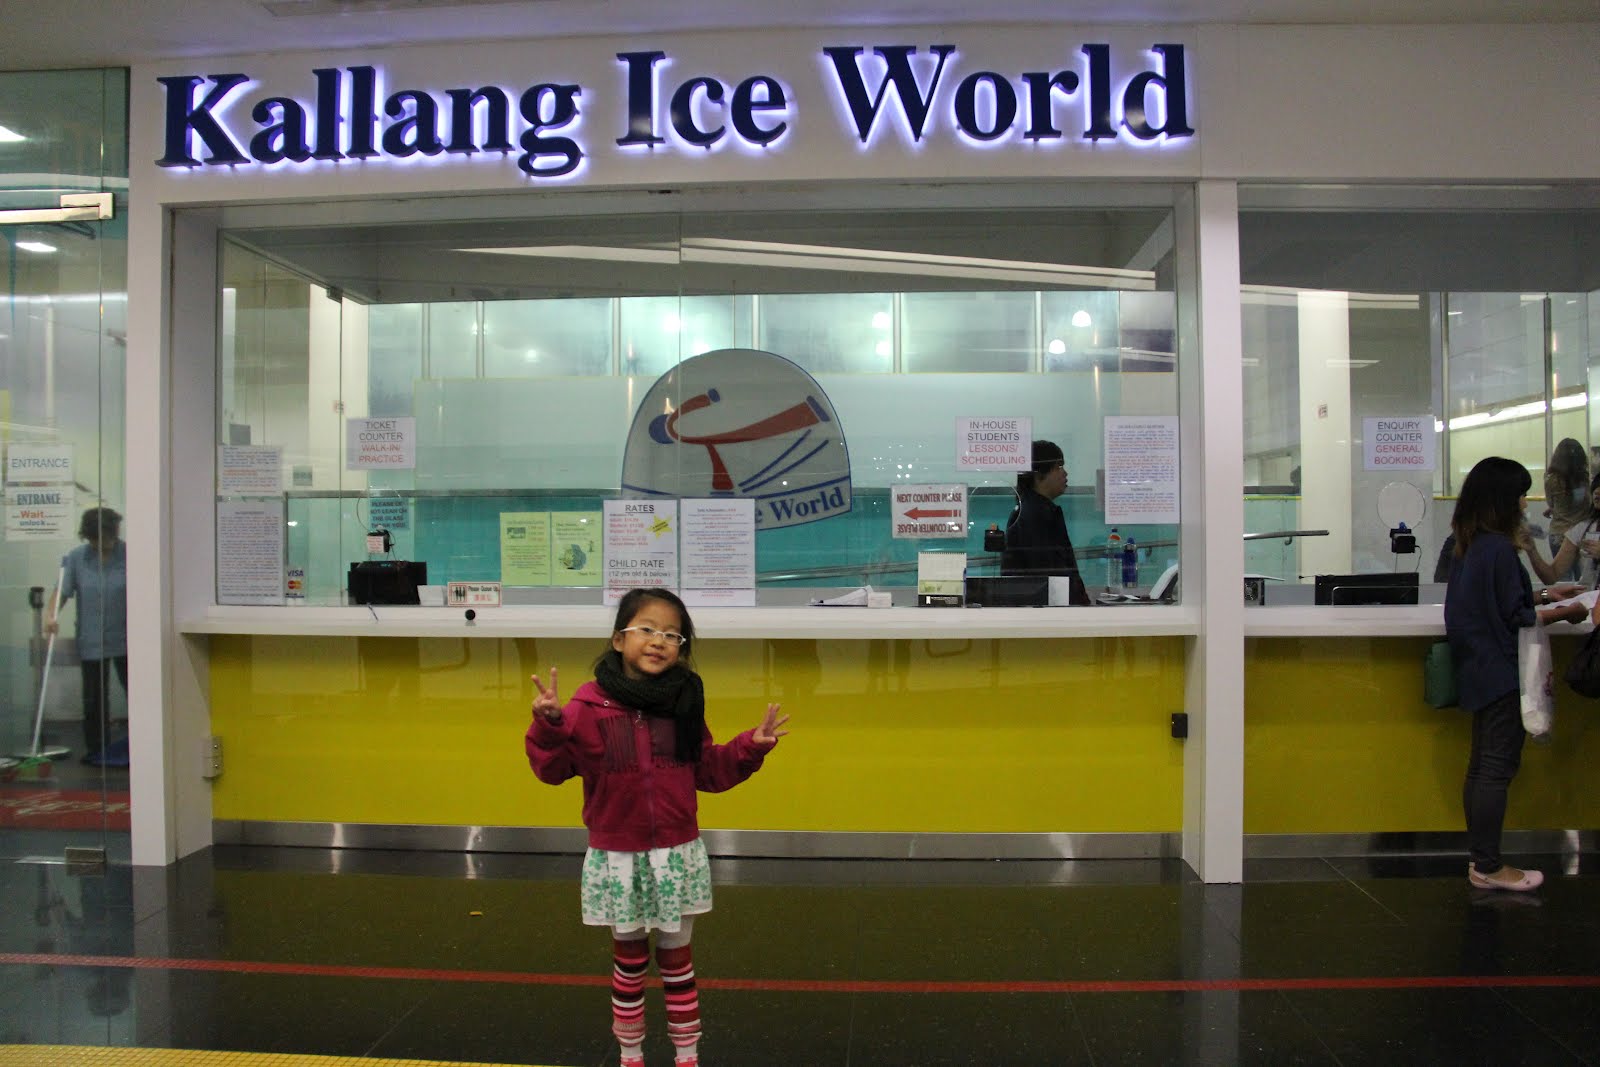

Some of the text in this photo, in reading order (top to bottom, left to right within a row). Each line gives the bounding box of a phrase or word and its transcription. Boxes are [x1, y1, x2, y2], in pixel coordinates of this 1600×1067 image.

[154, 43, 1195, 177] Kallang Ice World
[365, 421, 397, 430] TICKET
[969, 420, 1018, 429] IN-HOUSE
[1377, 421, 1420, 430] ENQUIRY
[359, 432, 404, 441] COUNTER
[967, 432, 1020, 441] STUDENTS
[1375, 432, 1423, 442] COUNTER
[968, 444, 1019, 453] LESSONS/
[11, 458, 69, 468] ENTRANCE
[358, 454, 404, 463] PRACTICE
[961, 455, 1026, 465] SCHEDULING
[1374, 455, 1425, 465] BOOKINGS
[17, 493, 61, 505] ENTRANCE
[896, 493, 912, 503] NEXT
[912, 493, 941, 503] COUNTER
[625, 504, 655, 512] RATES
[769, 486, 845, 521] World
[20, 510, 45, 519] Wait
[918, 523, 946, 533] COUNTER
[947, 523, 963, 533] NT
[608, 559, 665, 568] CHILD RATE
